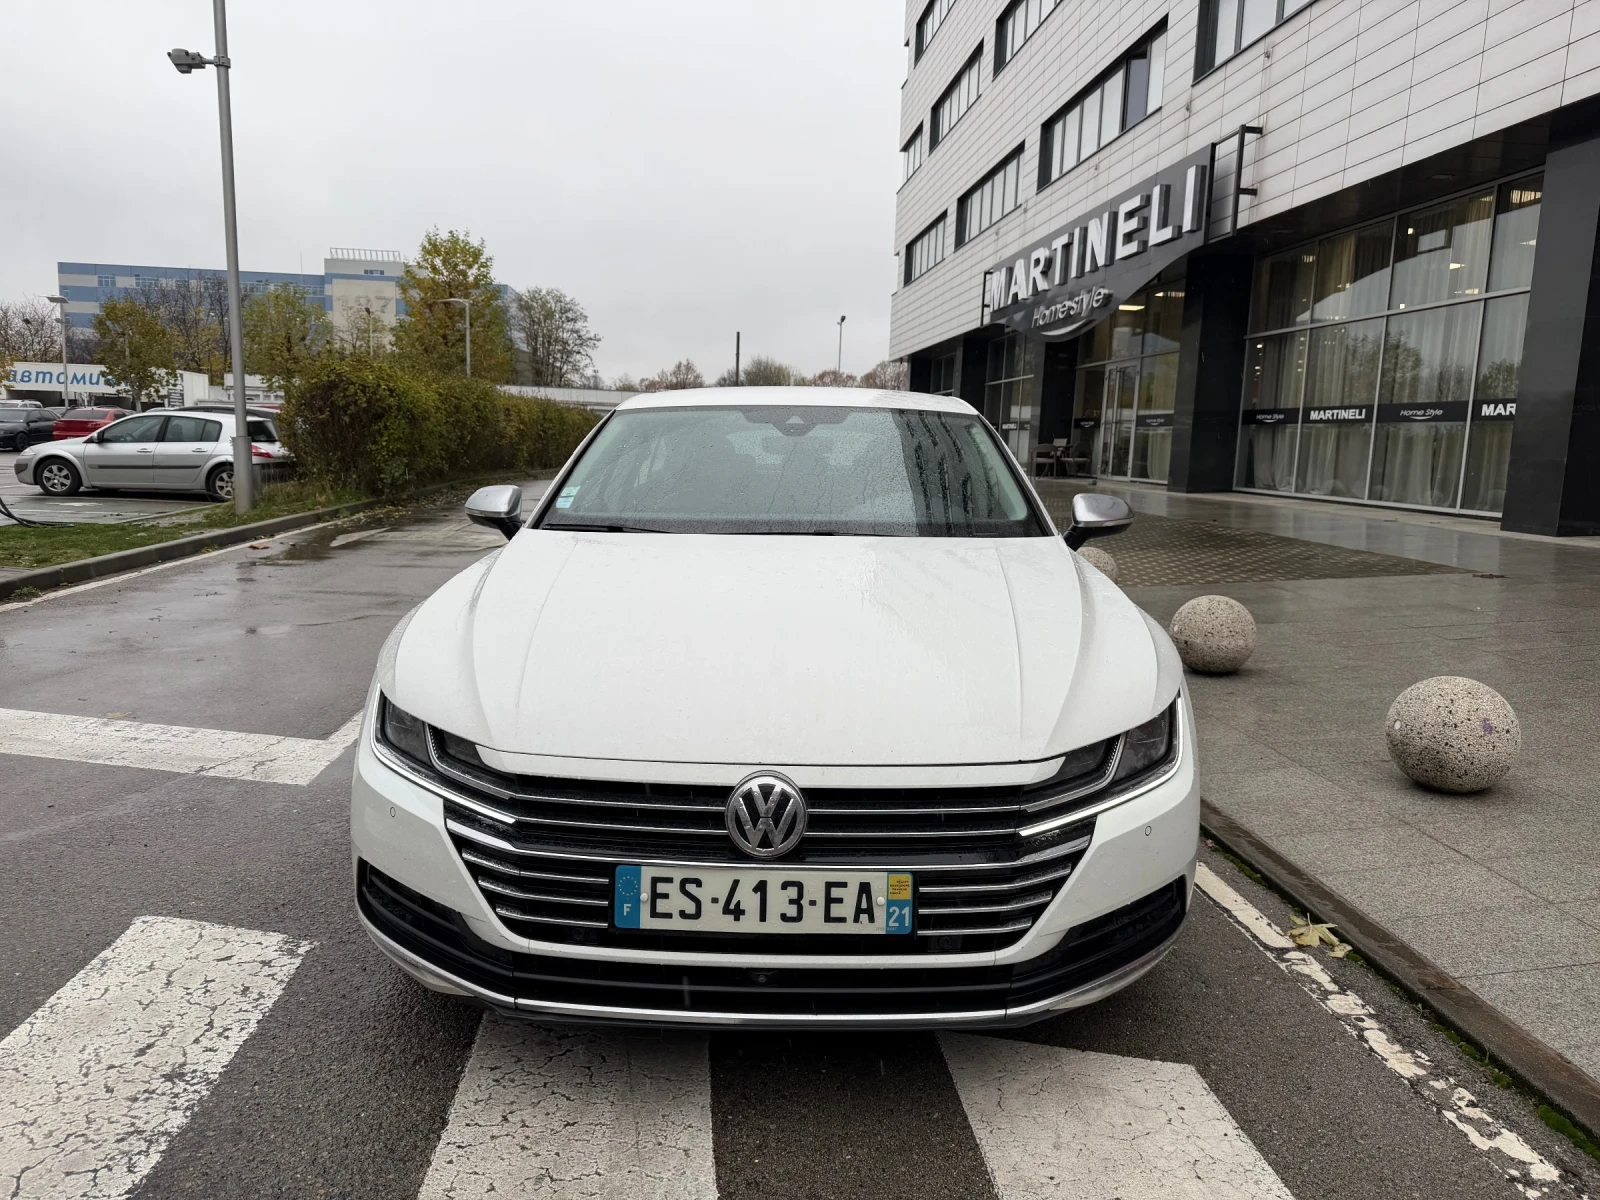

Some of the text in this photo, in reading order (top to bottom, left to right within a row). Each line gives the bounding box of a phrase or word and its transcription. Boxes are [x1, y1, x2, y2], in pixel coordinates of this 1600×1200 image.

[989, 164, 1207, 312] MARTINELI
[1309, 408, 1366, 421] MARTINELI
[622, 903, 632, 917] F
[649, 876, 876, 924] ES-413-EA
[888, 906, 910, 927] 21
